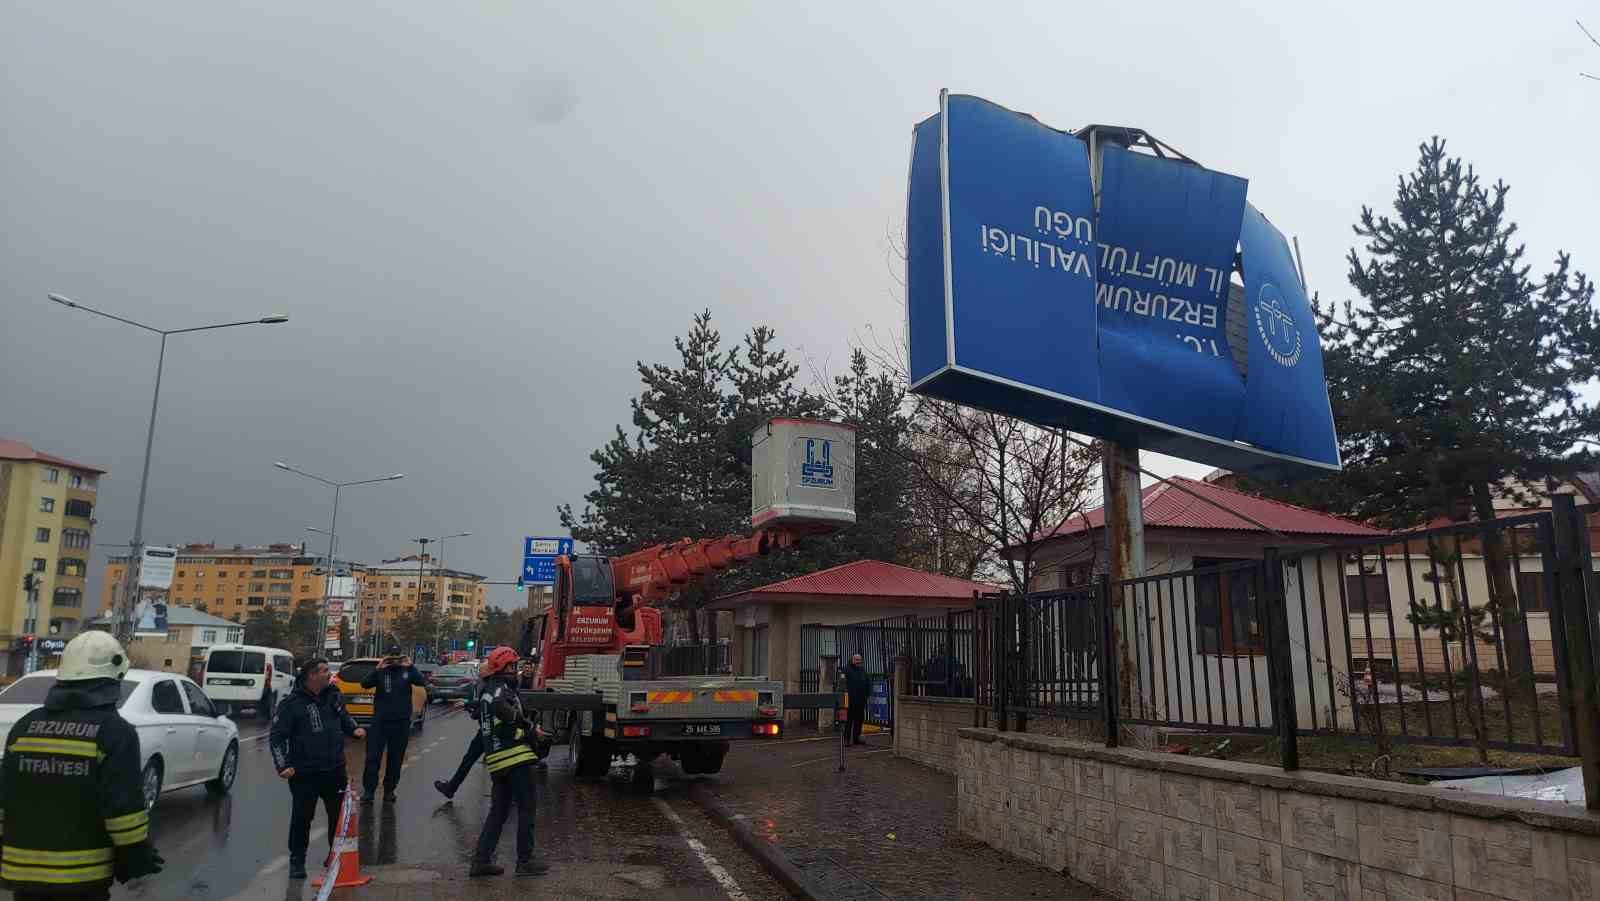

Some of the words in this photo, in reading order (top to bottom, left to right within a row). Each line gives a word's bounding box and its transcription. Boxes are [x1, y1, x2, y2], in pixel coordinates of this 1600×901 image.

[981, 224, 1092, 278] VALİLİĞİ
[1204, 267, 1224, 299] İL
[1096, 281, 1217, 329] ERZURUM
[576, 617, 609, 625] ERZURUM
[27, 720, 101, 737] ERZURUM
[19, 755, 89, 776] İTFAİYESİ
